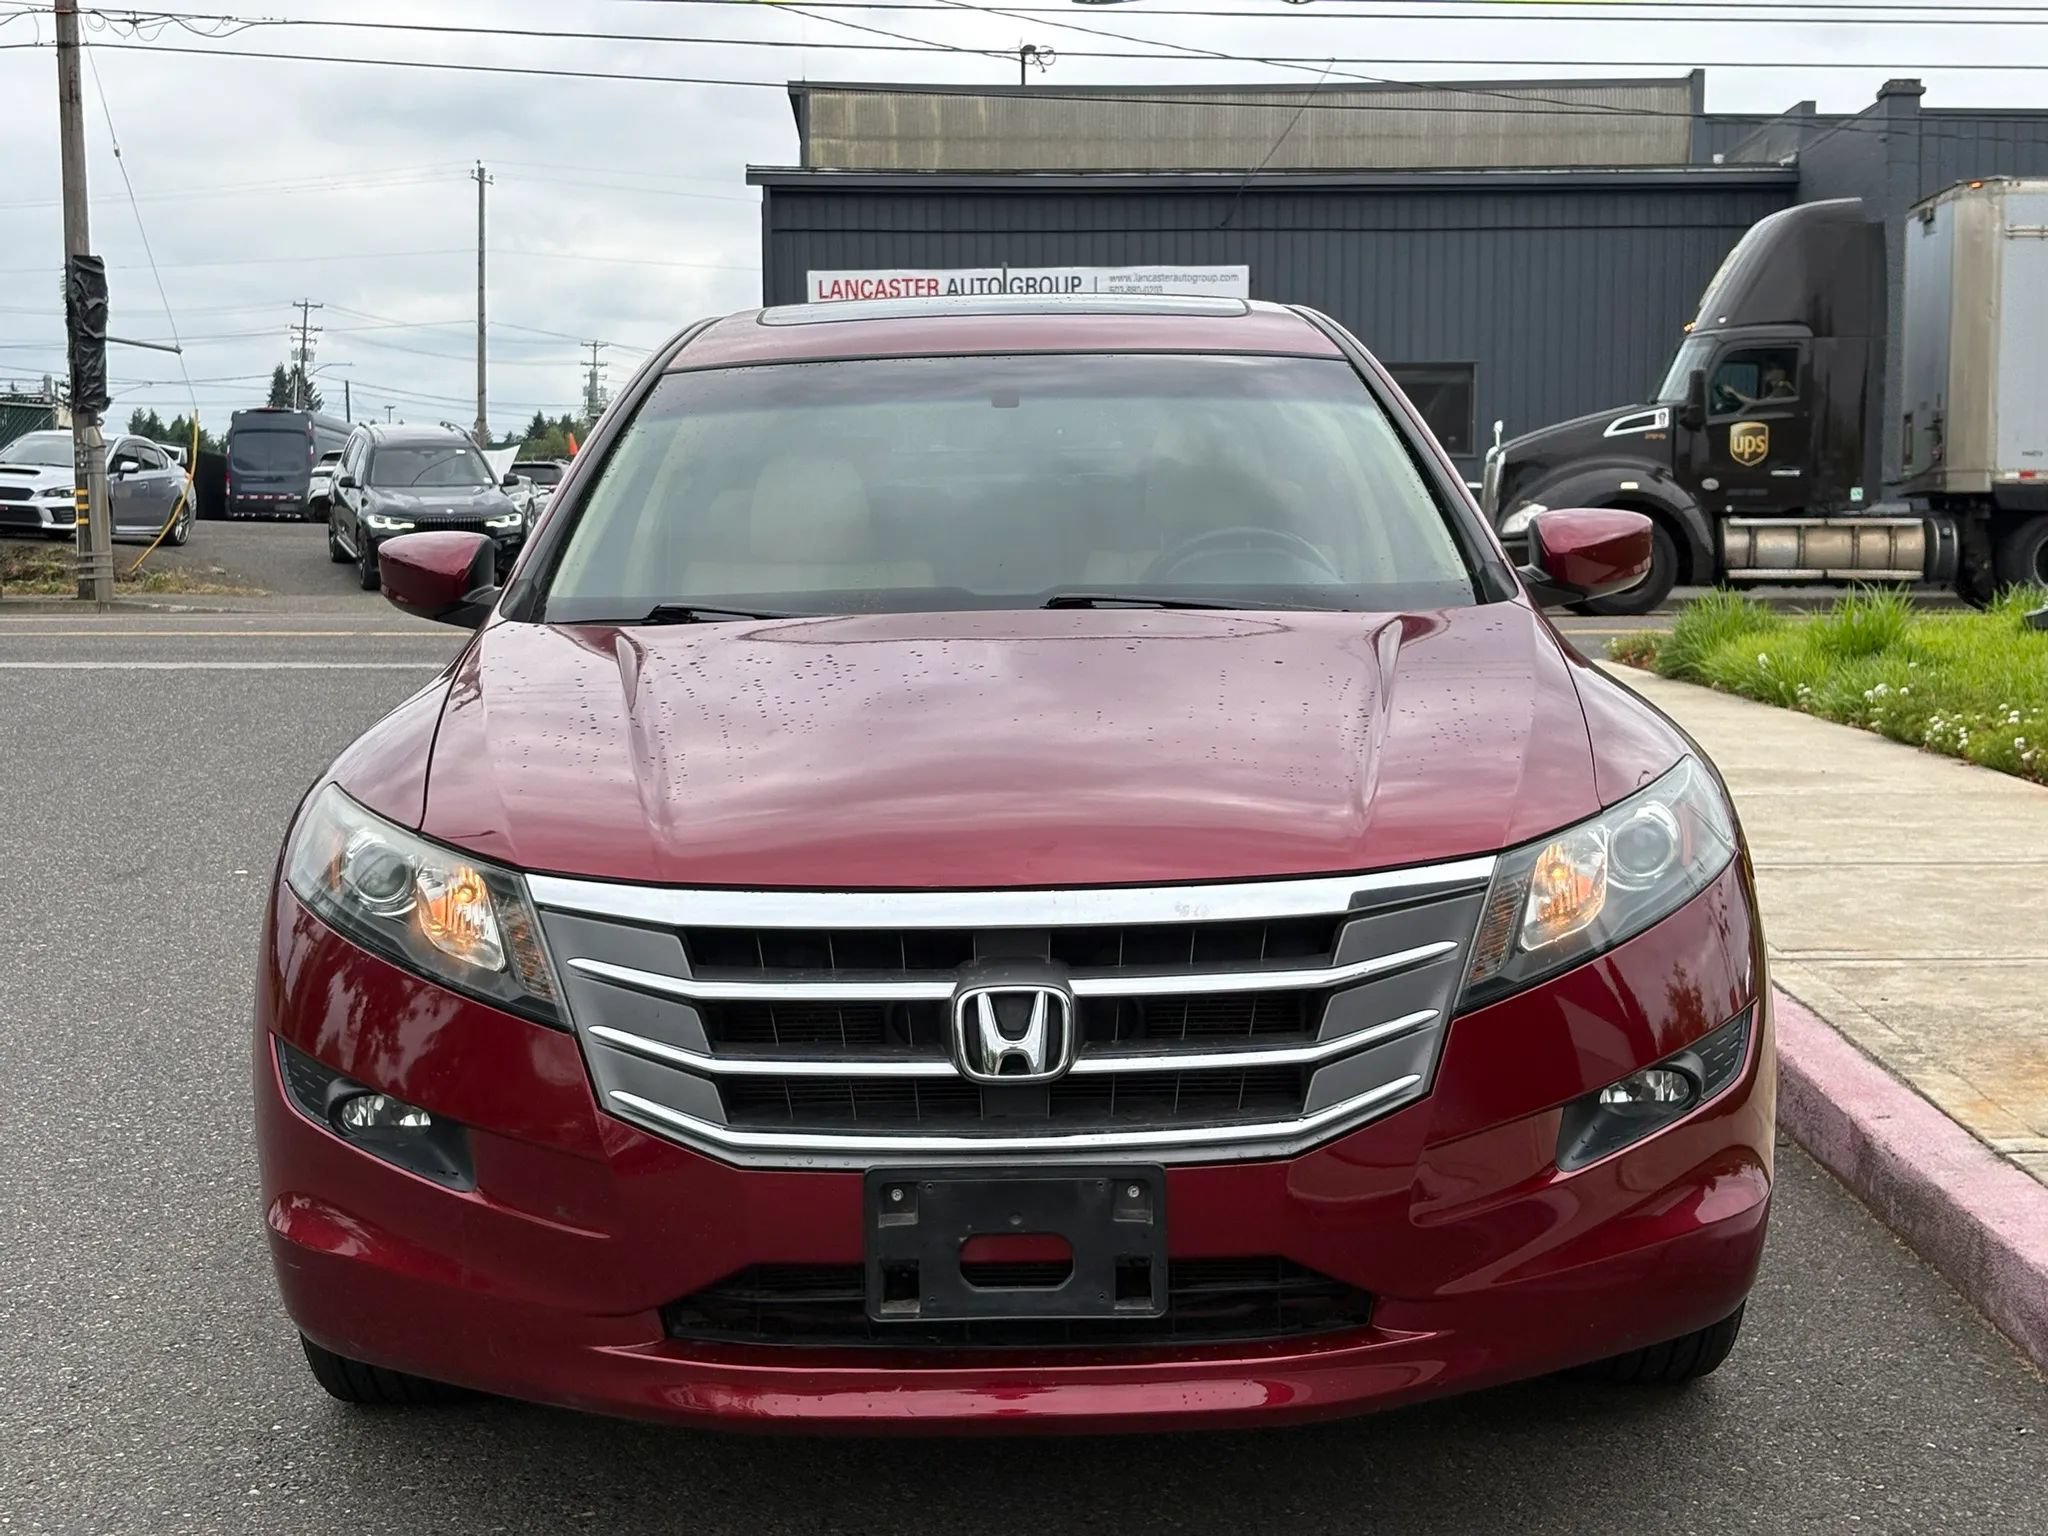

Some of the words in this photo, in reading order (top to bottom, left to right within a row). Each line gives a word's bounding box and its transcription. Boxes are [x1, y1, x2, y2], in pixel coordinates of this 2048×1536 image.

[818, 278, 939, 300] LANCASTER
[946, 277, 1001, 296] AUTO
[1009, 276, 1083, 294] GROUP
[1108, 272, 1240, 285] www.lancasterautogroup.com
[1733, 435, 1766, 459] ups
